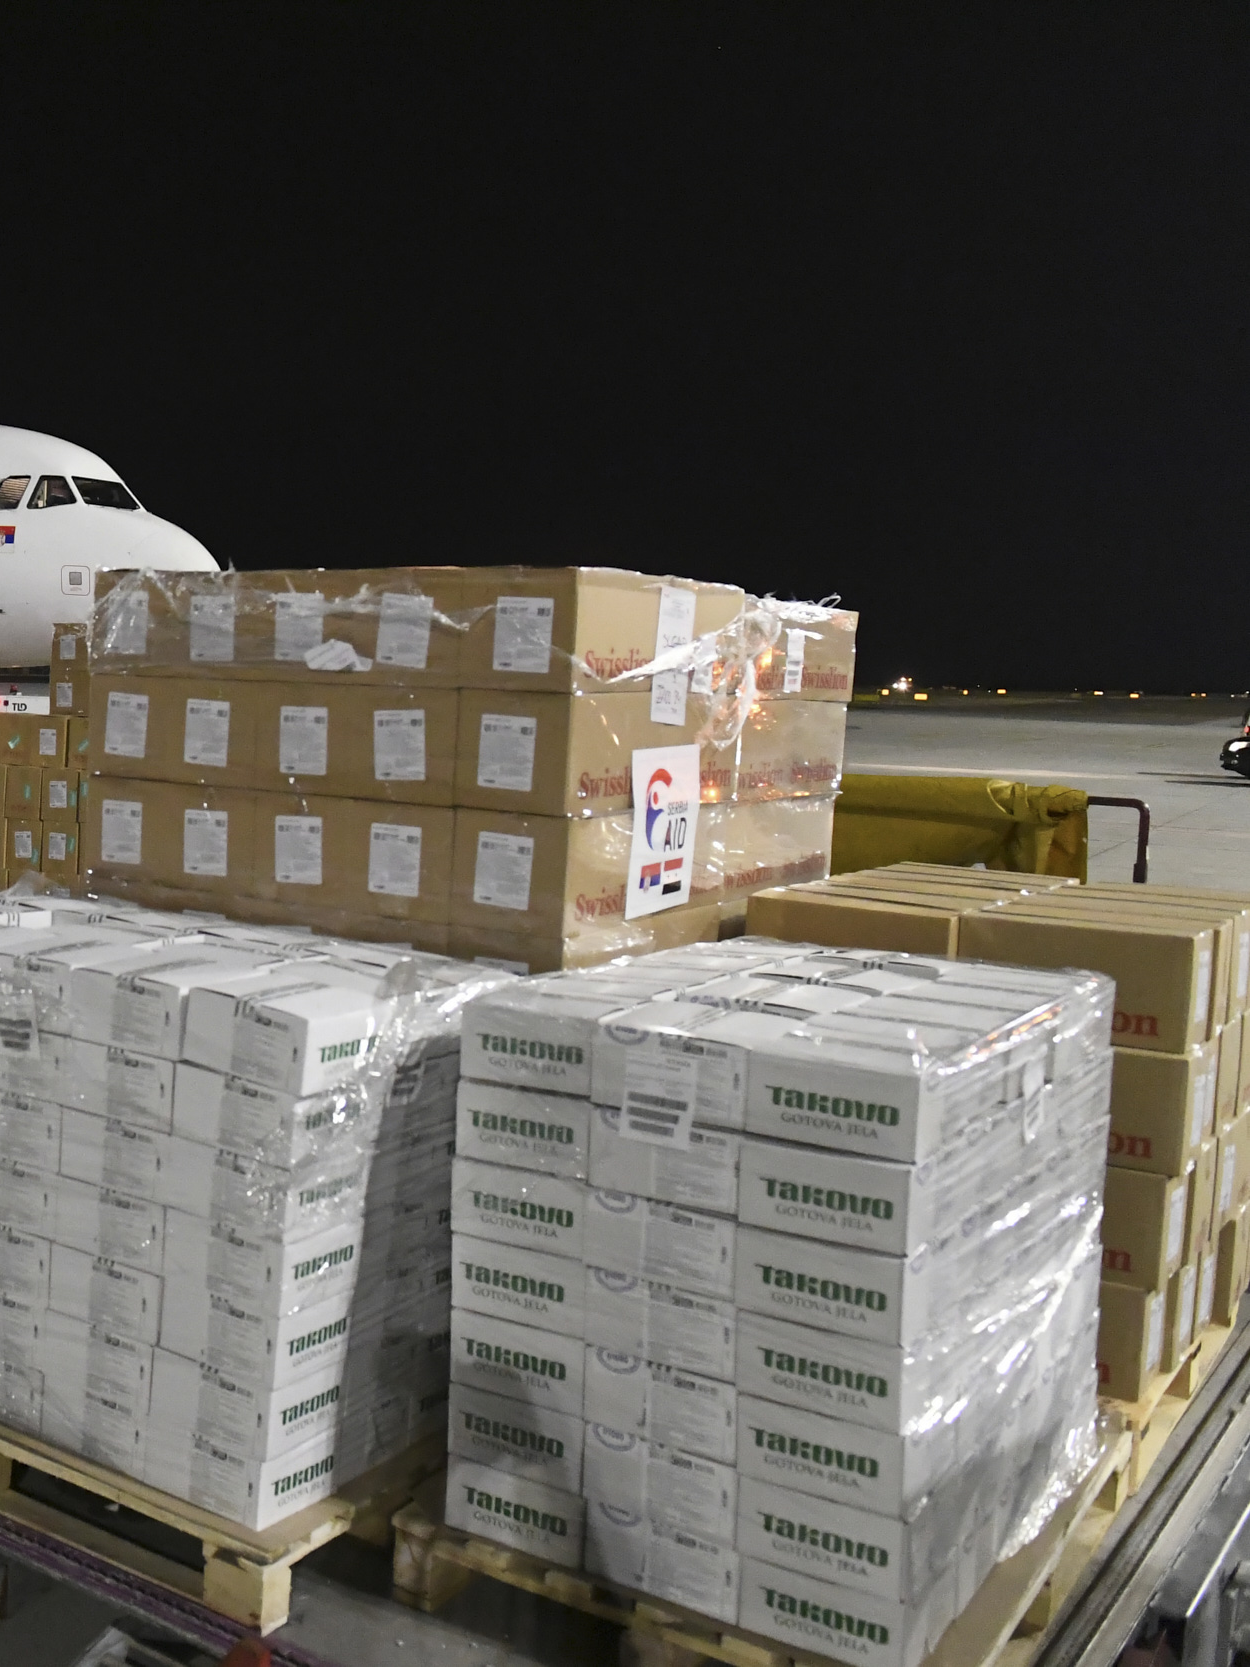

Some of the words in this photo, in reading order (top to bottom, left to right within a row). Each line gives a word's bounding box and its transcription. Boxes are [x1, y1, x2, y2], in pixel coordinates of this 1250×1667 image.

[12, 702, 27, 712] TLD
[578, 766, 631, 800] Swissl
[664, 817, 688, 852] AID
[574, 884, 625, 921] Swissl
[781, 1112, 843, 1133] GOTOVA
[847, 1123, 879, 1139] JELA
[775, 1204, 837, 1226] GOTOVA
[841, 1216, 873, 1232] JELA
